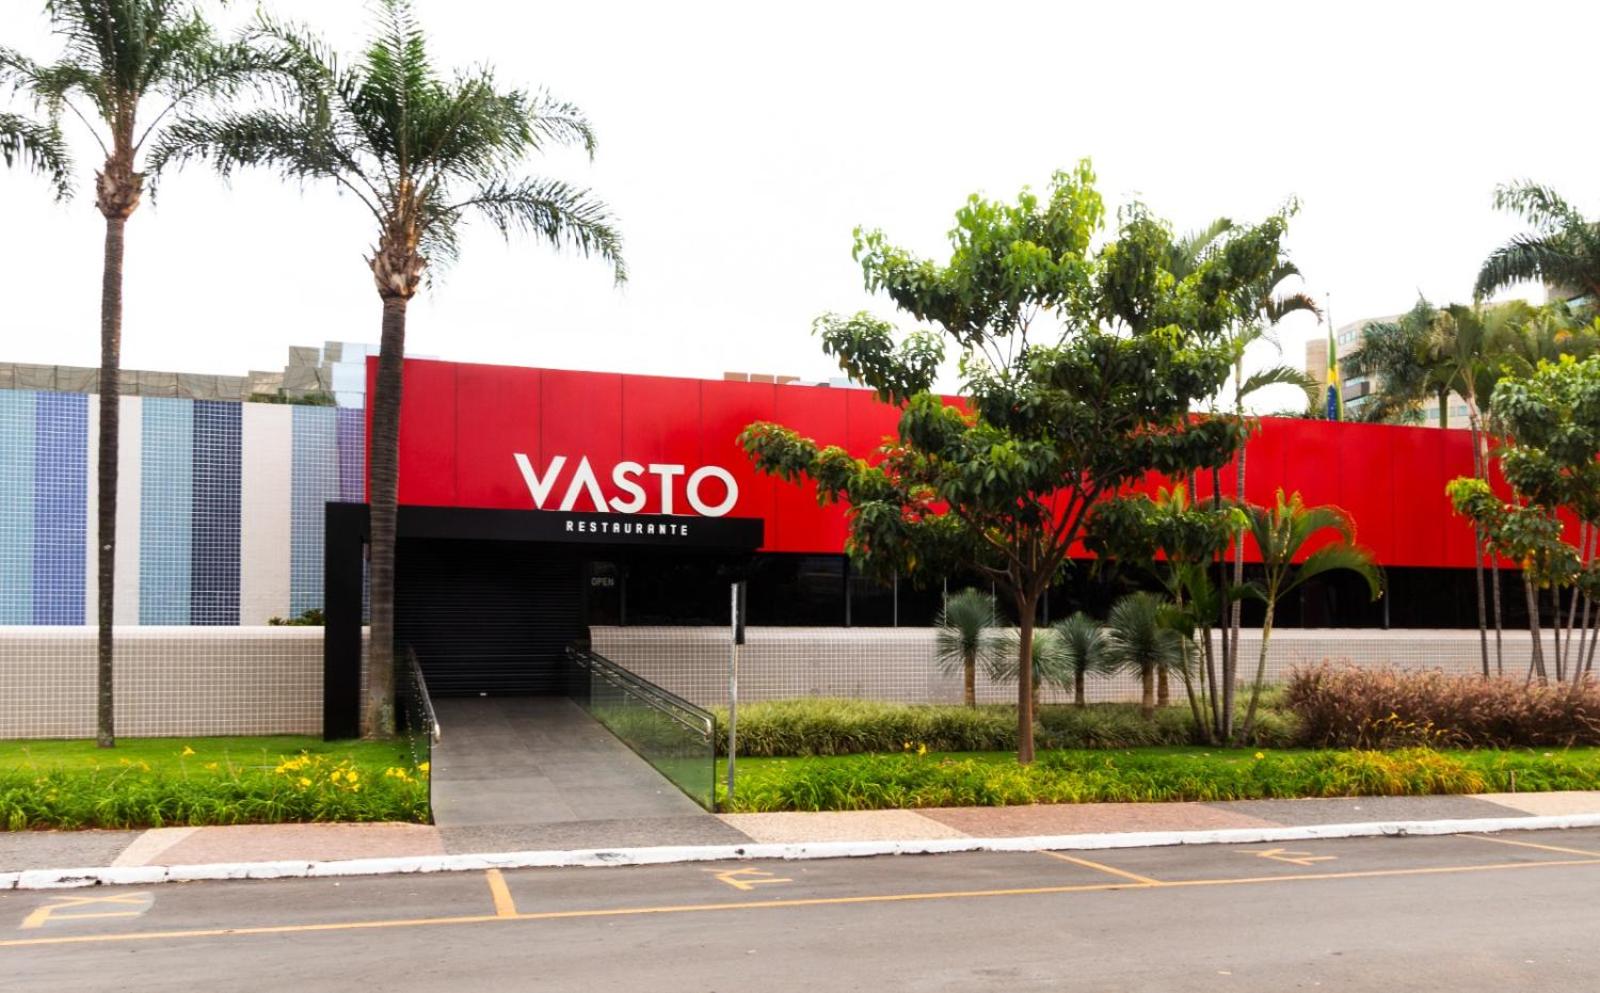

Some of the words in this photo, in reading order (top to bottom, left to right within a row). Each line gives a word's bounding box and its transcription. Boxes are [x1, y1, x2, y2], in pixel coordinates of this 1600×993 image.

[513, 453, 738, 517] VASTO
[565, 520, 688, 536] RESTAURANTE
[591, 577, 615, 587] OPEN
